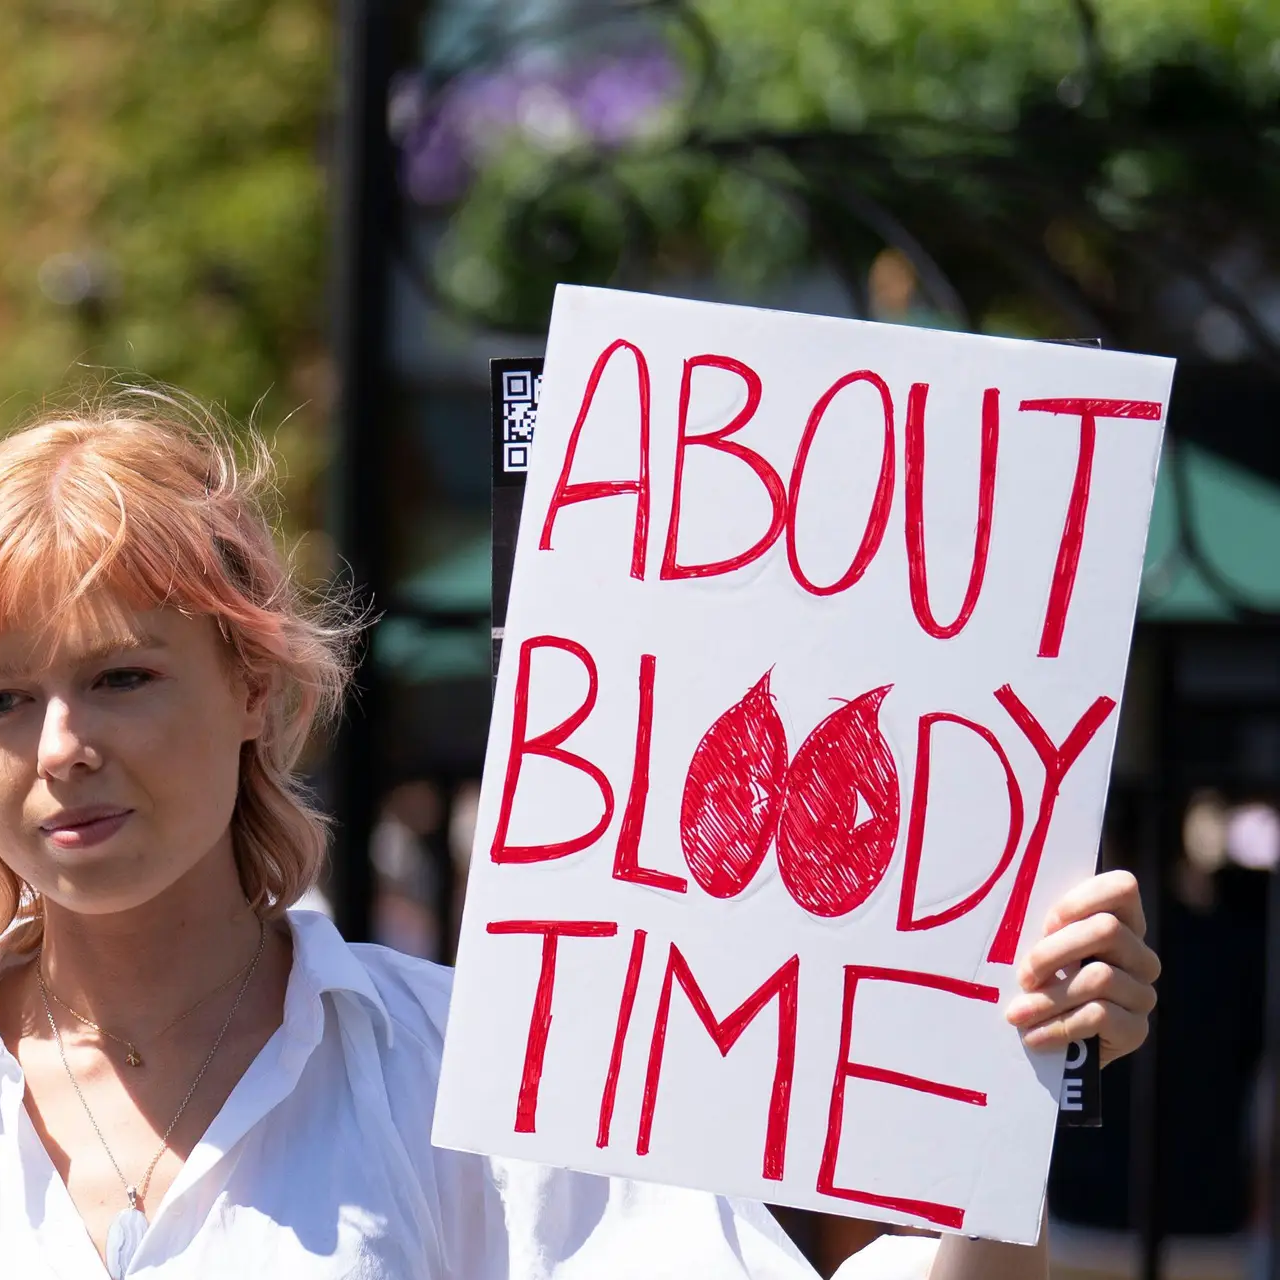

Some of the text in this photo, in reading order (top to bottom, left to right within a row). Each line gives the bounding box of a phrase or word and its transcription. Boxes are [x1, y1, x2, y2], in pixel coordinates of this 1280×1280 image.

[537, 338, 1162, 660] ABOUT
[490, 632, 1117, 966] BLOODY
[485, 919, 1001, 1229] TIME
